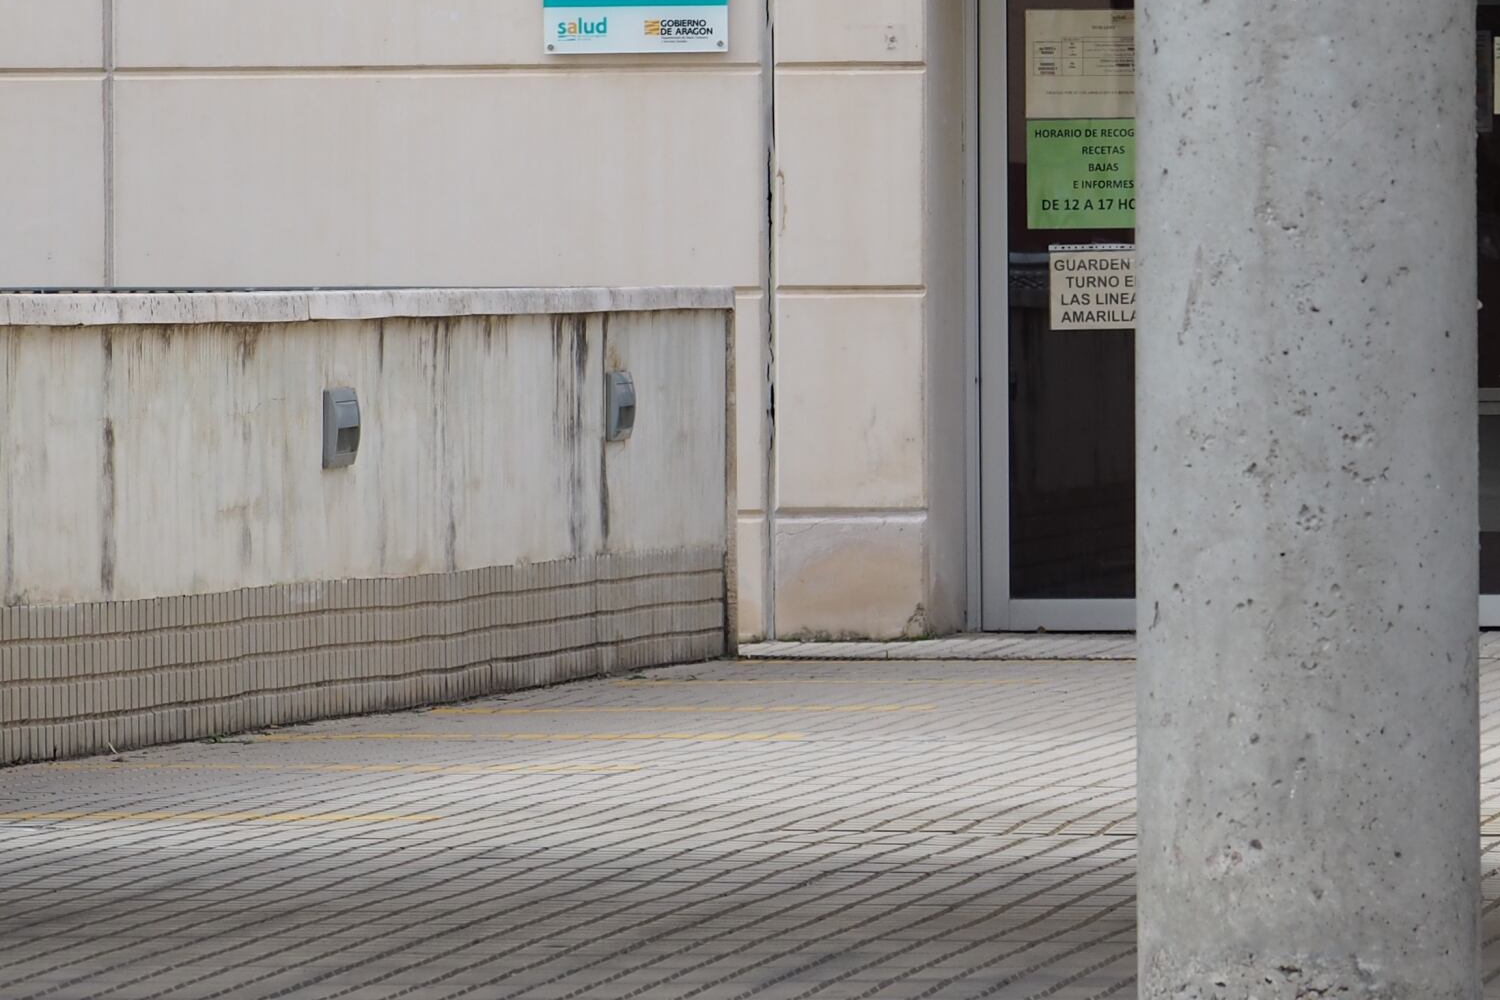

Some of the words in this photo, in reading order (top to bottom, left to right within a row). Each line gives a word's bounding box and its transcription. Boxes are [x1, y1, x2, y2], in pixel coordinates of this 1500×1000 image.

[557, 16, 607, 35] salud
[660, 19, 707, 28] GOBIERNO
[660, 27, 672, 36] DE
[1034, 128, 1081, 138] HORARIO
[1084, 128, 1098, 137] DE
[1100, 128, 1135, 137] RECOG
[1081, 145, 1125, 155] RECETAS
[1088, 162, 1119, 172] BAJAS
[1072, 180, 1079, 189] E
[1081, 179, 1135, 189] INFORMES
[1041, 199, 1060, 211] DE
[1063, 199, 1080, 211] 12
[1083, 199, 1094, 210] A
[1098, 198, 1114, 210] 17
[1054, 258, 1130, 272] GUARDEN
[1065, 275, 1120, 288] TURNO
[1124, 275, 1136, 288] E
[1060, 293, 1090, 306] LAS
